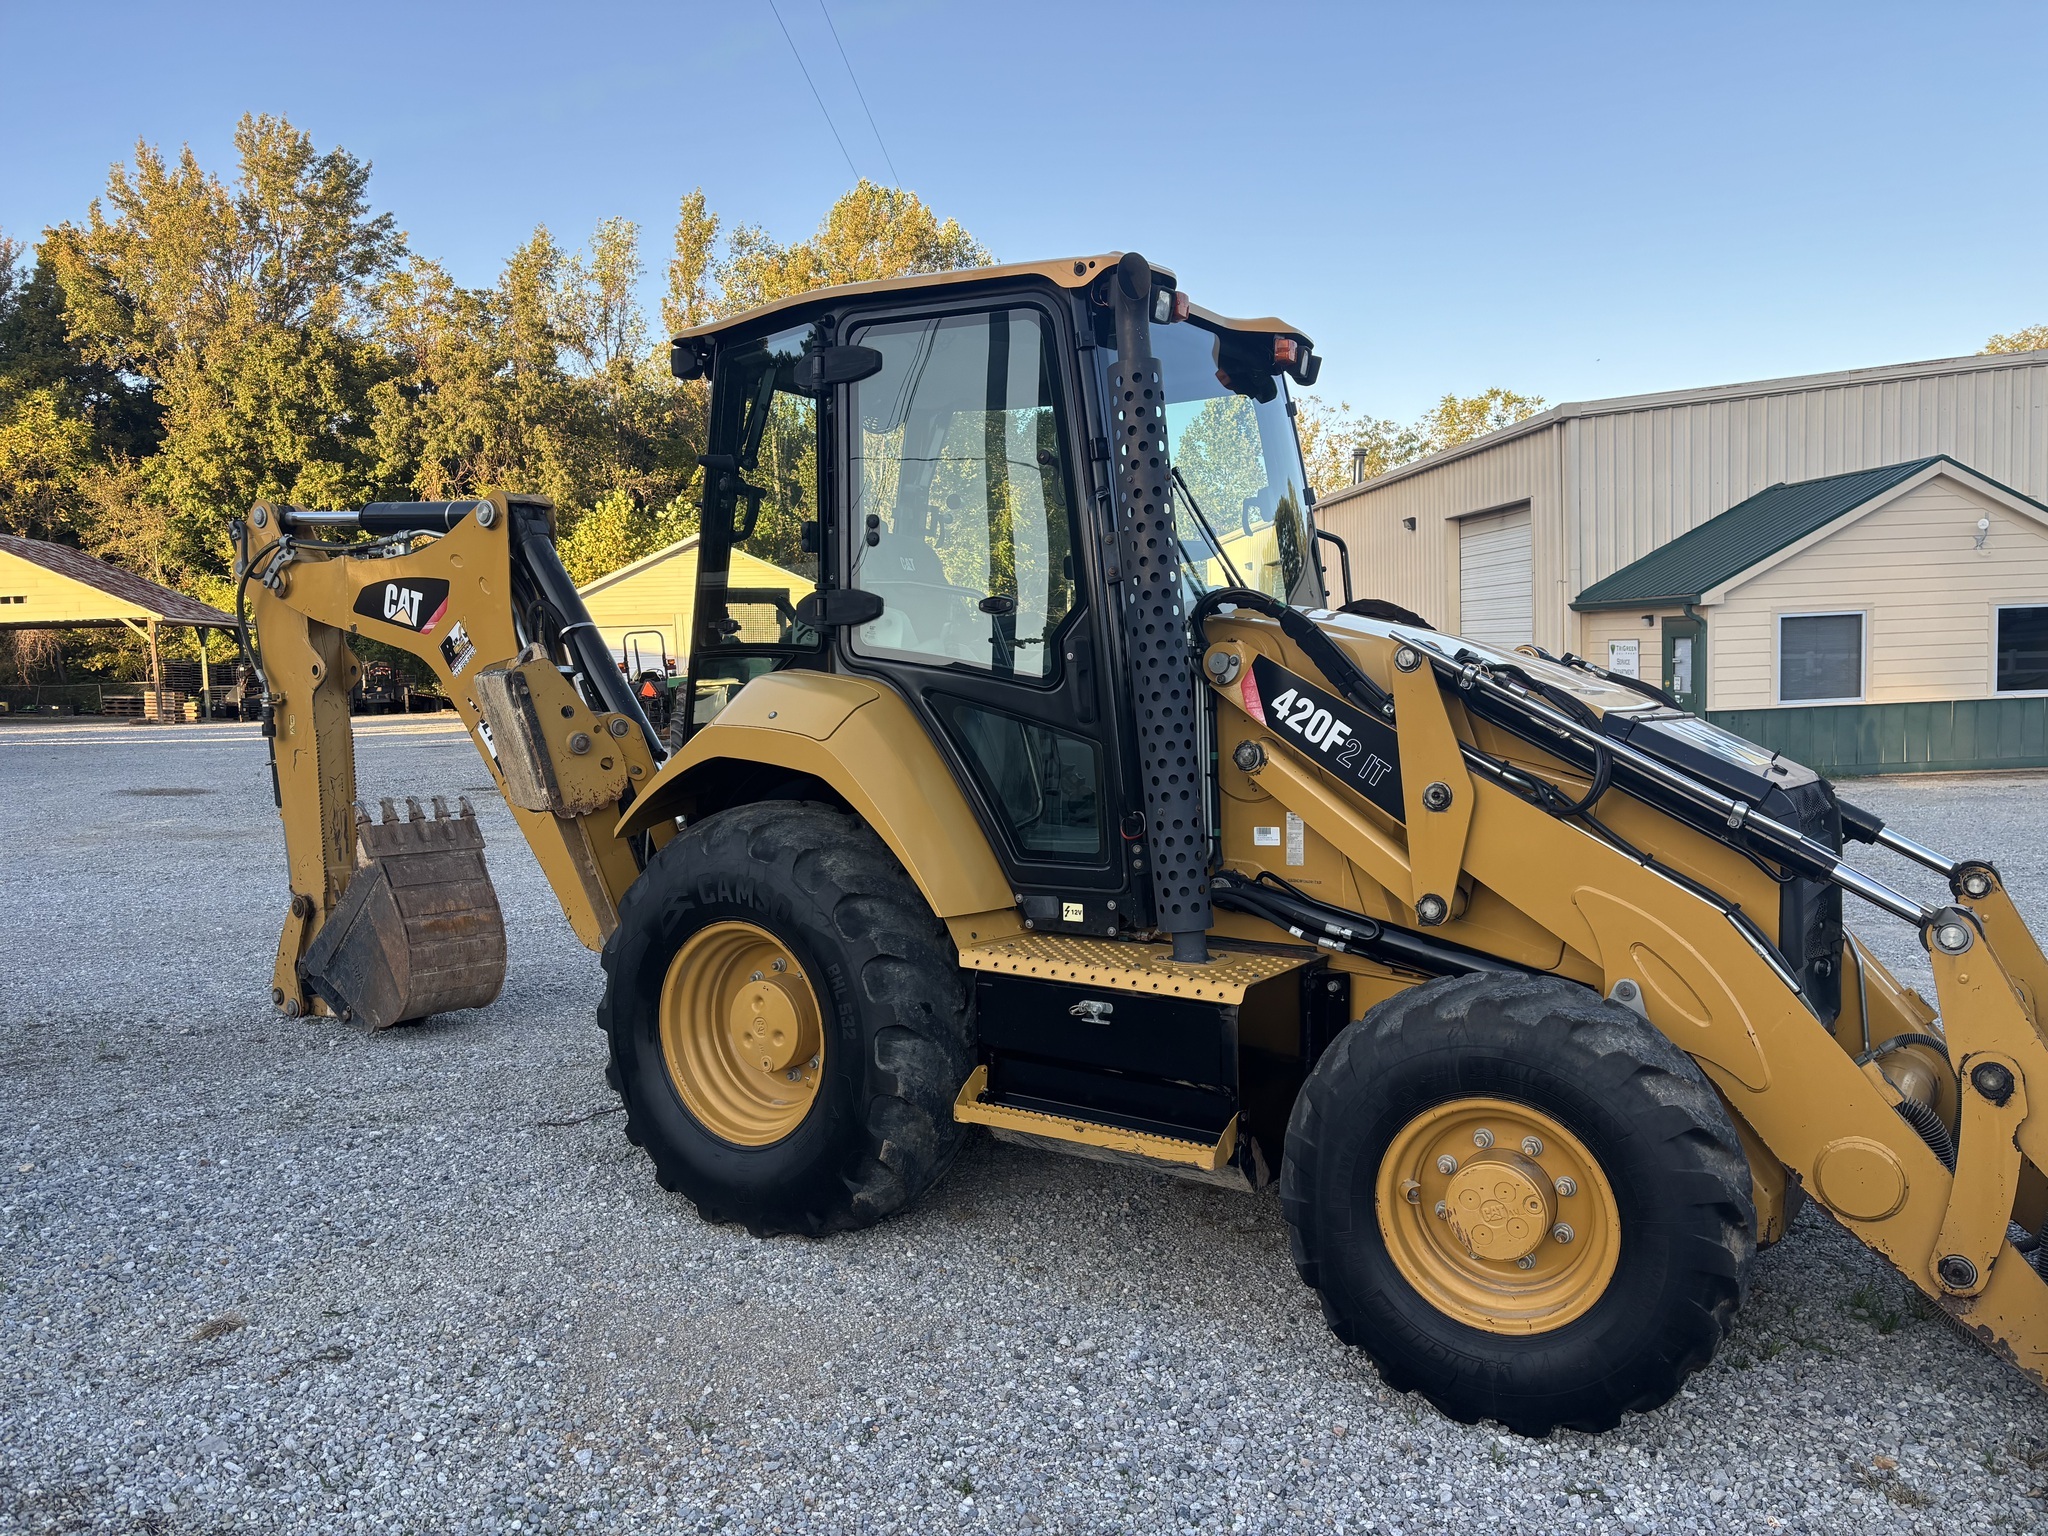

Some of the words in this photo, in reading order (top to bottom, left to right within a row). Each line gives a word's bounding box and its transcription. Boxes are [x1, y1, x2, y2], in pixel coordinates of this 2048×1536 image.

[900, 556, 916, 571] CAT
[383, 583, 424, 627] CAT
[1358, 753, 1392, 787] IT
[697, 872, 793, 922] CAMSO
[825, 962, 847, 1001] BHL
[838, 1002, 857, 1040] 532
[1482, 1205, 1506, 1223] CAT
